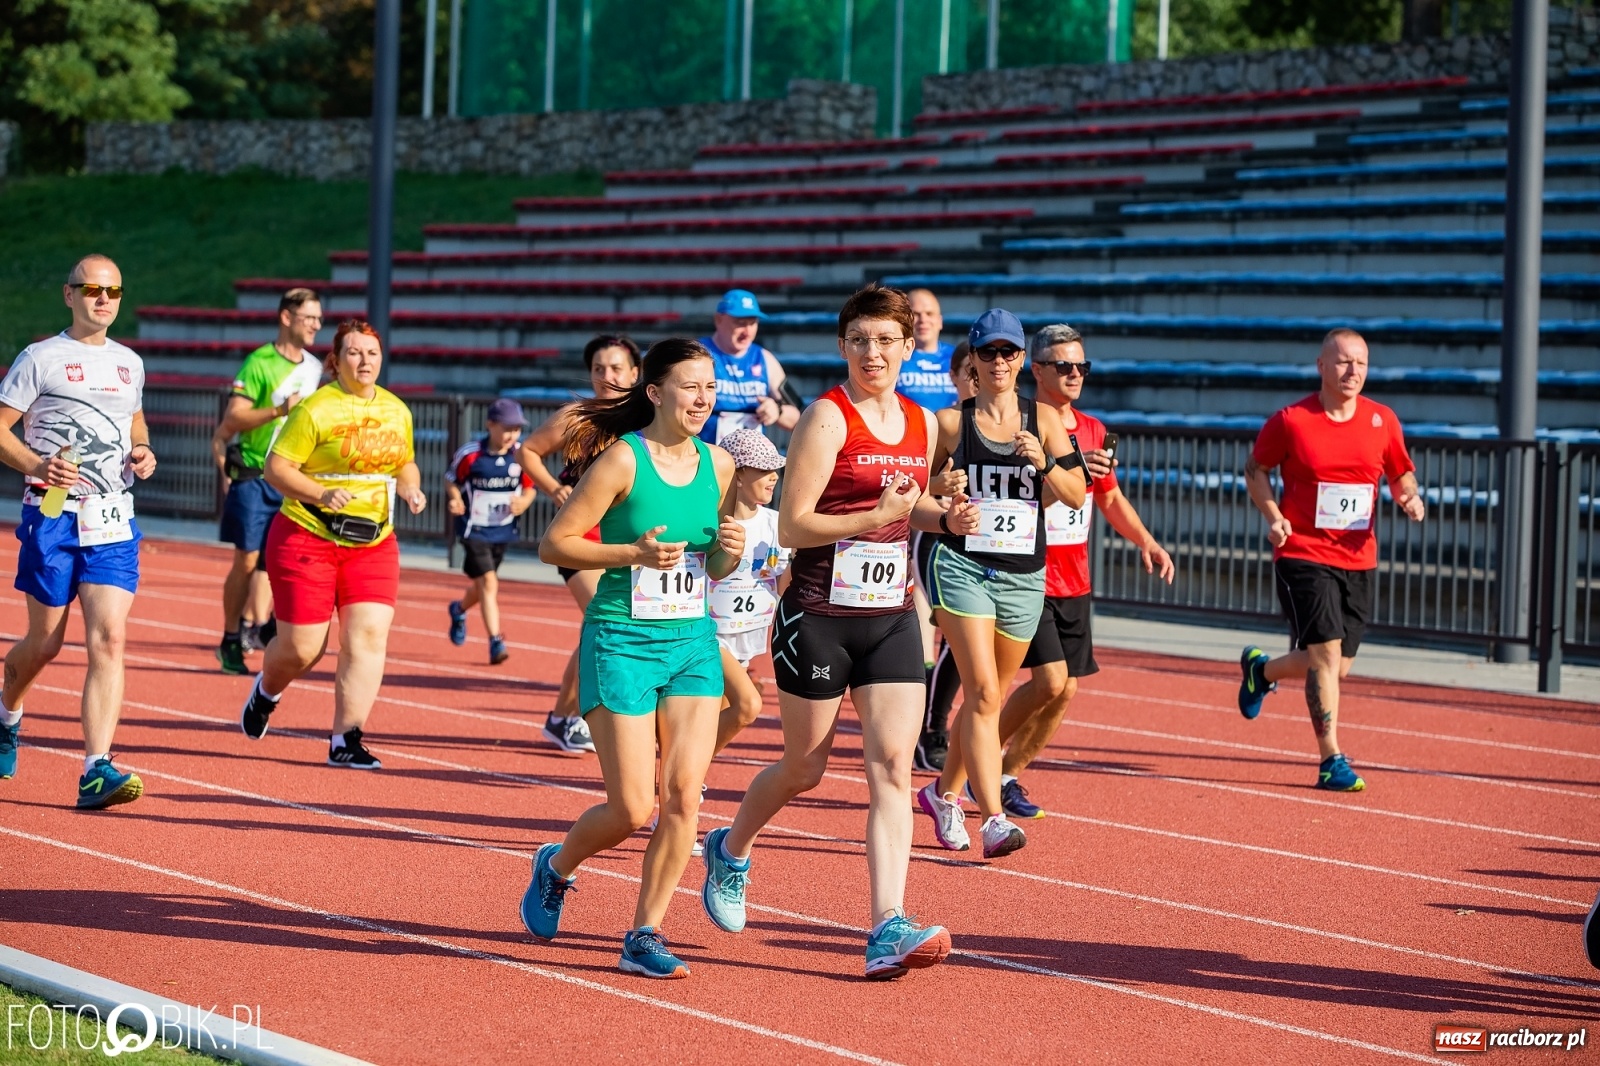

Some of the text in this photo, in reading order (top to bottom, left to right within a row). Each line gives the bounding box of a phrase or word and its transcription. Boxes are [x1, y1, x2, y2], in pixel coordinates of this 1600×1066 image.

[897, 371, 955, 387] UNNE
[857, 454, 927, 467] DAR-BUD
[968, 463, 1037, 499] LET'S
[1340, 498, 1356, 513] 91
[101, 507, 121, 524] 54
[994, 514, 1016, 533] 25
[1069, 510, 1084, 526] 31
[861, 561, 895, 584] 109
[659, 571, 694, 594] 110
[733, 595, 755, 613] 26
